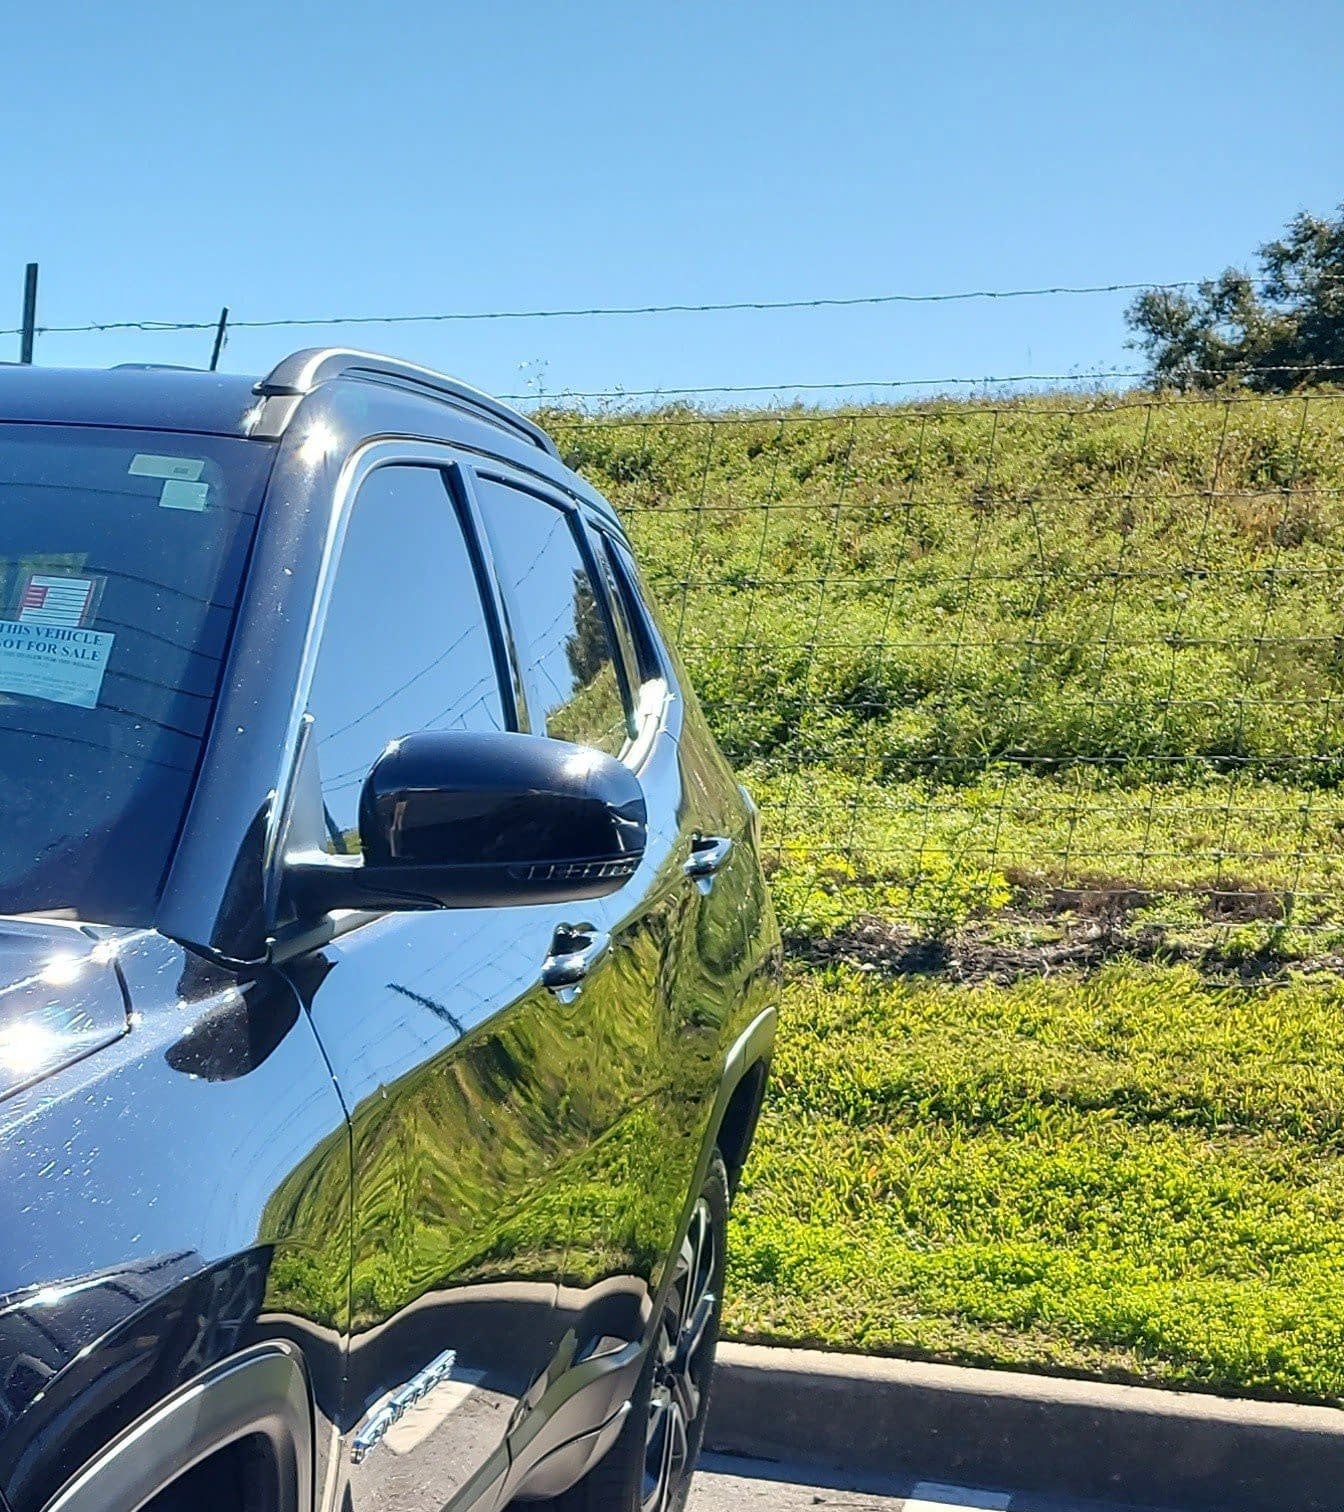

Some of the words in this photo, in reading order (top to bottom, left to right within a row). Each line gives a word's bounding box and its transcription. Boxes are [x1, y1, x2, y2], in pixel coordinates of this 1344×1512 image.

[35, 626, 104, 646] VEHICLE
[26, 640, 58, 655] FOR
[61, 645, 102, 662] SALE
